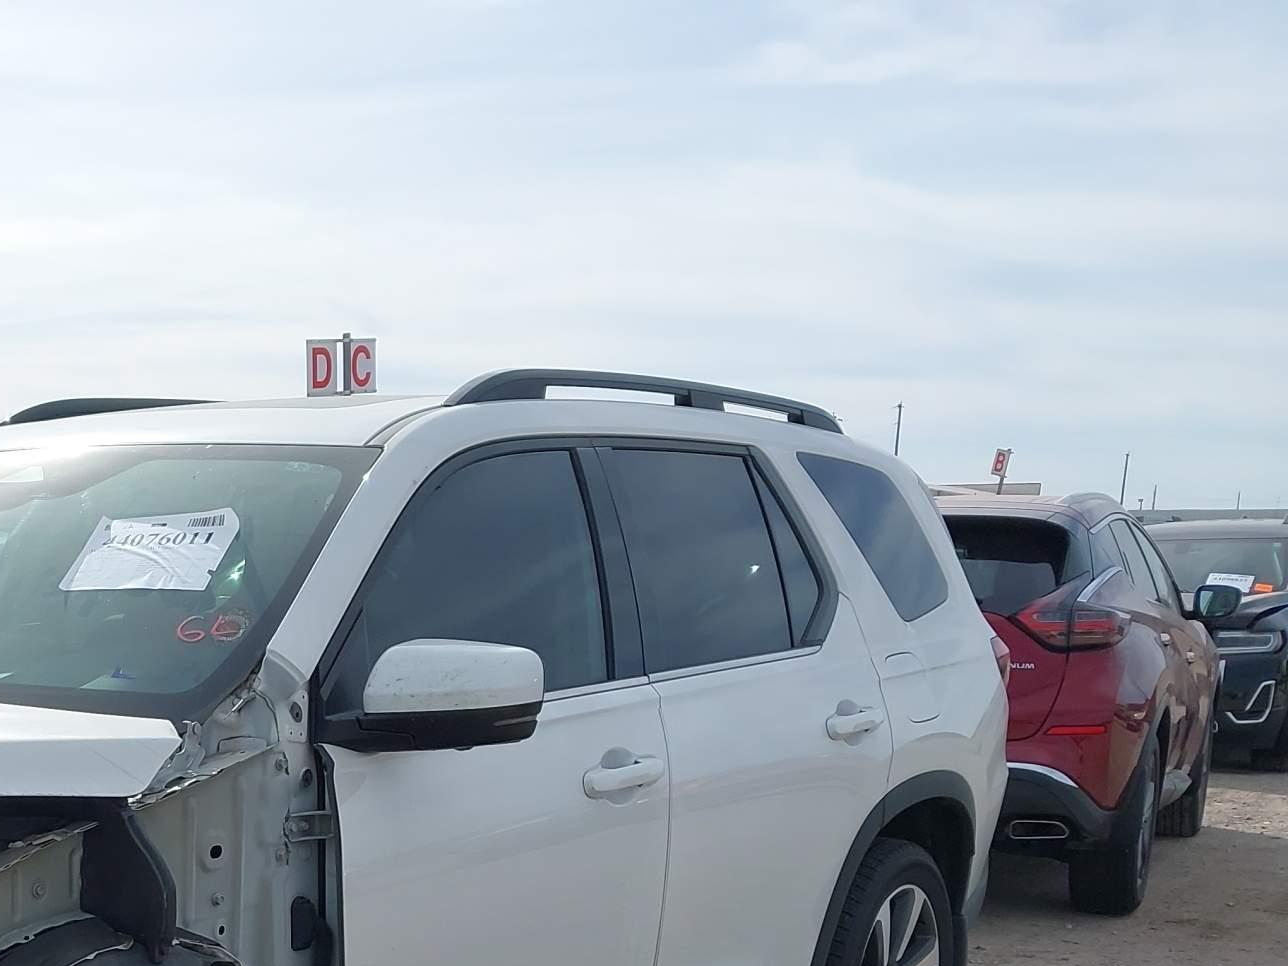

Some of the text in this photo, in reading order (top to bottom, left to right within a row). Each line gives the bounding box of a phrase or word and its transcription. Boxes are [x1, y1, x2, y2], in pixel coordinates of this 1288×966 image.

[312, 347, 333, 389] D
[351, 344, 372, 387] C
[994, 452, 1006, 472] B
[102, 531, 215, 547] 44076011
